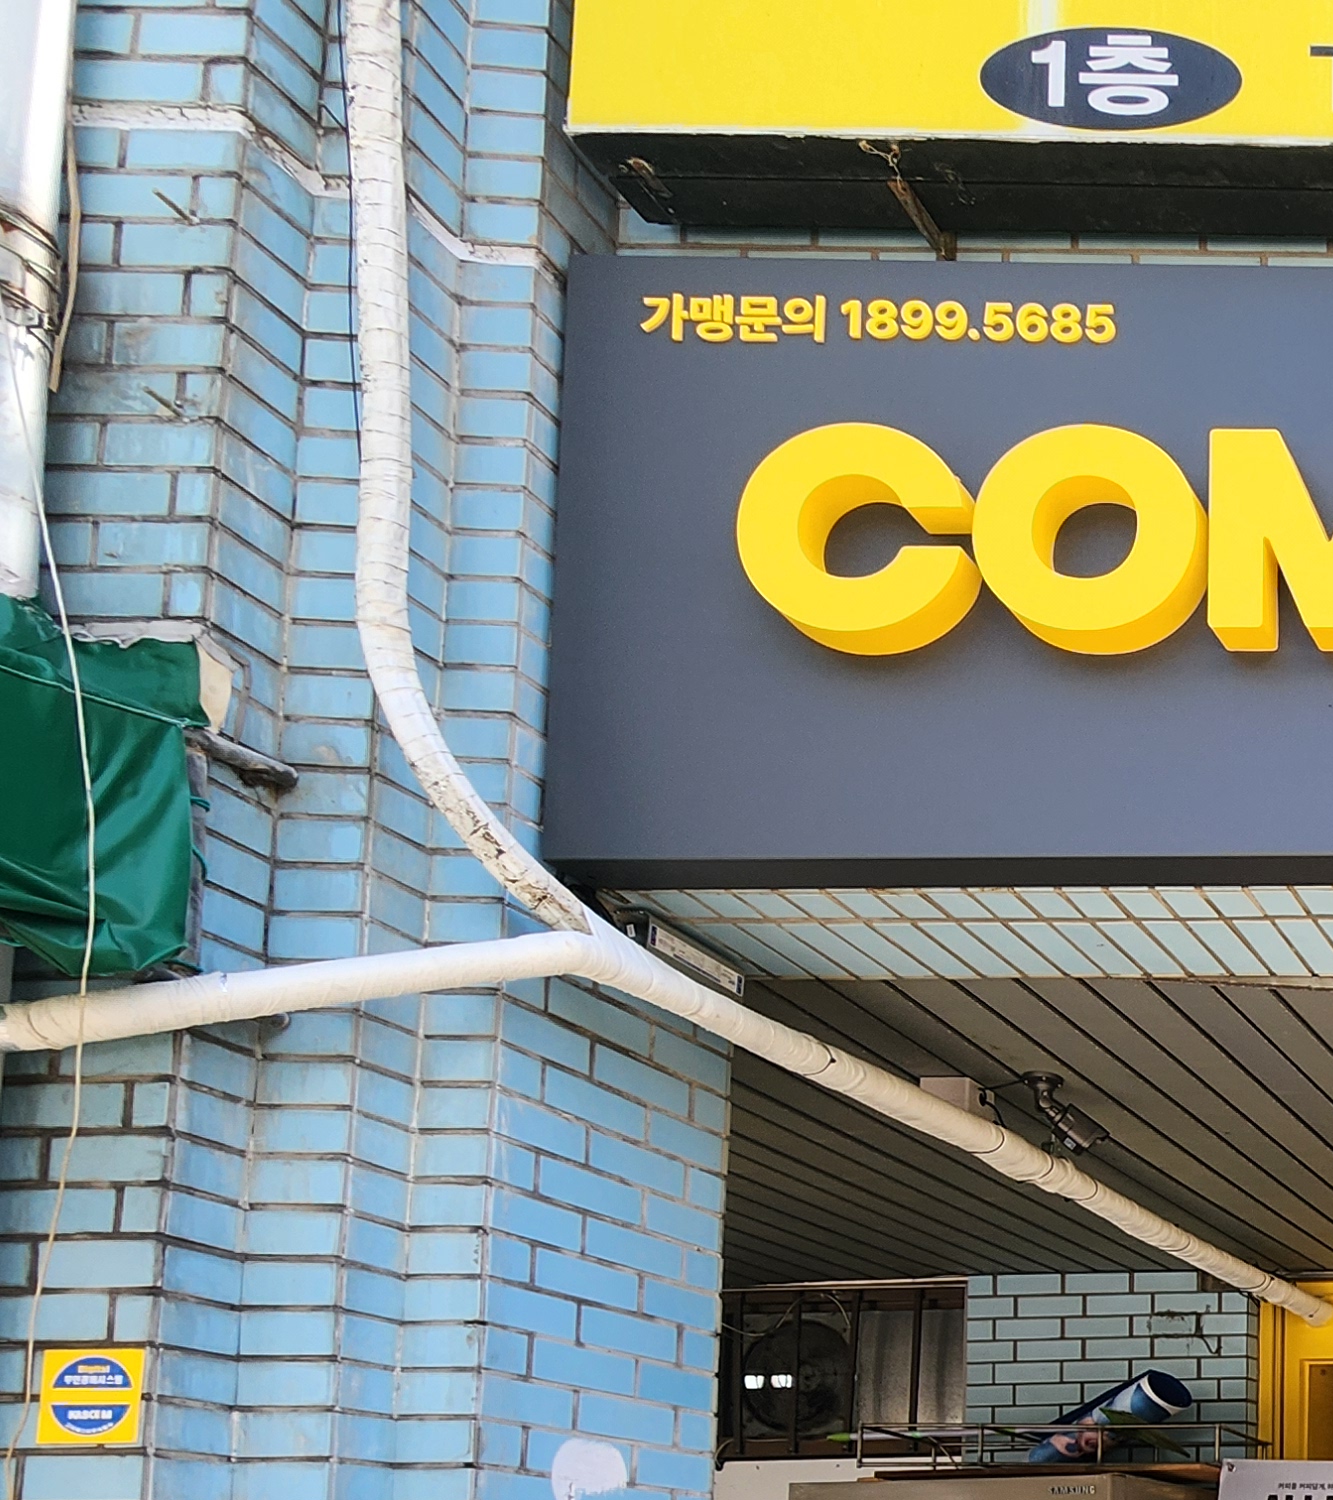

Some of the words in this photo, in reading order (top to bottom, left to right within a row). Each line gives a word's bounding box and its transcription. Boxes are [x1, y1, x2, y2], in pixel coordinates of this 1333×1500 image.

[1029, 35, 1180, 116] 1층
[640, 293, 826, 344] 가맹문의
[840, 298, 1117, 344] 1899.5685
[1048, 1485, 1096, 1495] SAMSUNG
